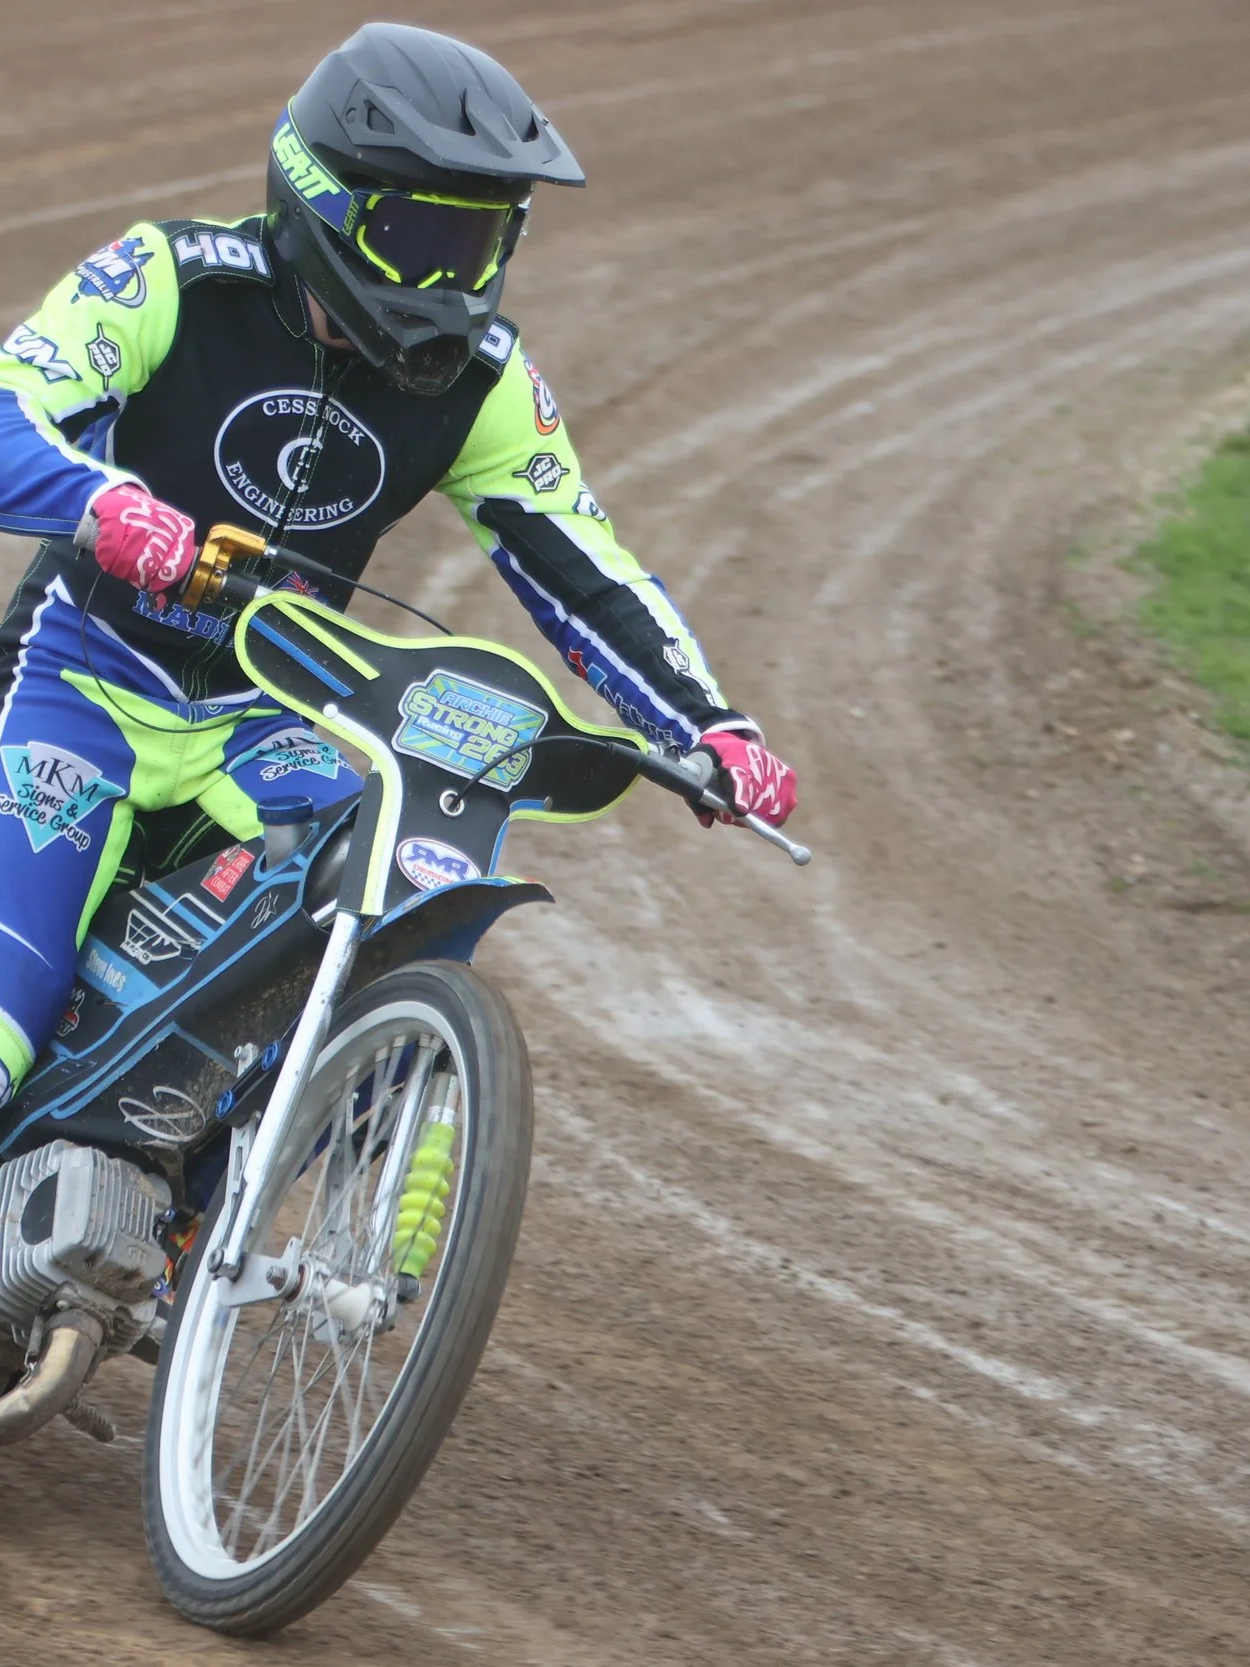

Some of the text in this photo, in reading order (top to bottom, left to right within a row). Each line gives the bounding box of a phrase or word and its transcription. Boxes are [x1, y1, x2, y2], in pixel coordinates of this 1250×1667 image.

[272, 122, 340, 199] LEATT
[408, 690, 519, 747] STRONG
[440, 690, 514, 726] ARCHIE
[15, 756, 101, 804] MKM
[17, 783, 78, 819] Signs &
[50, 815, 89, 849] Group
